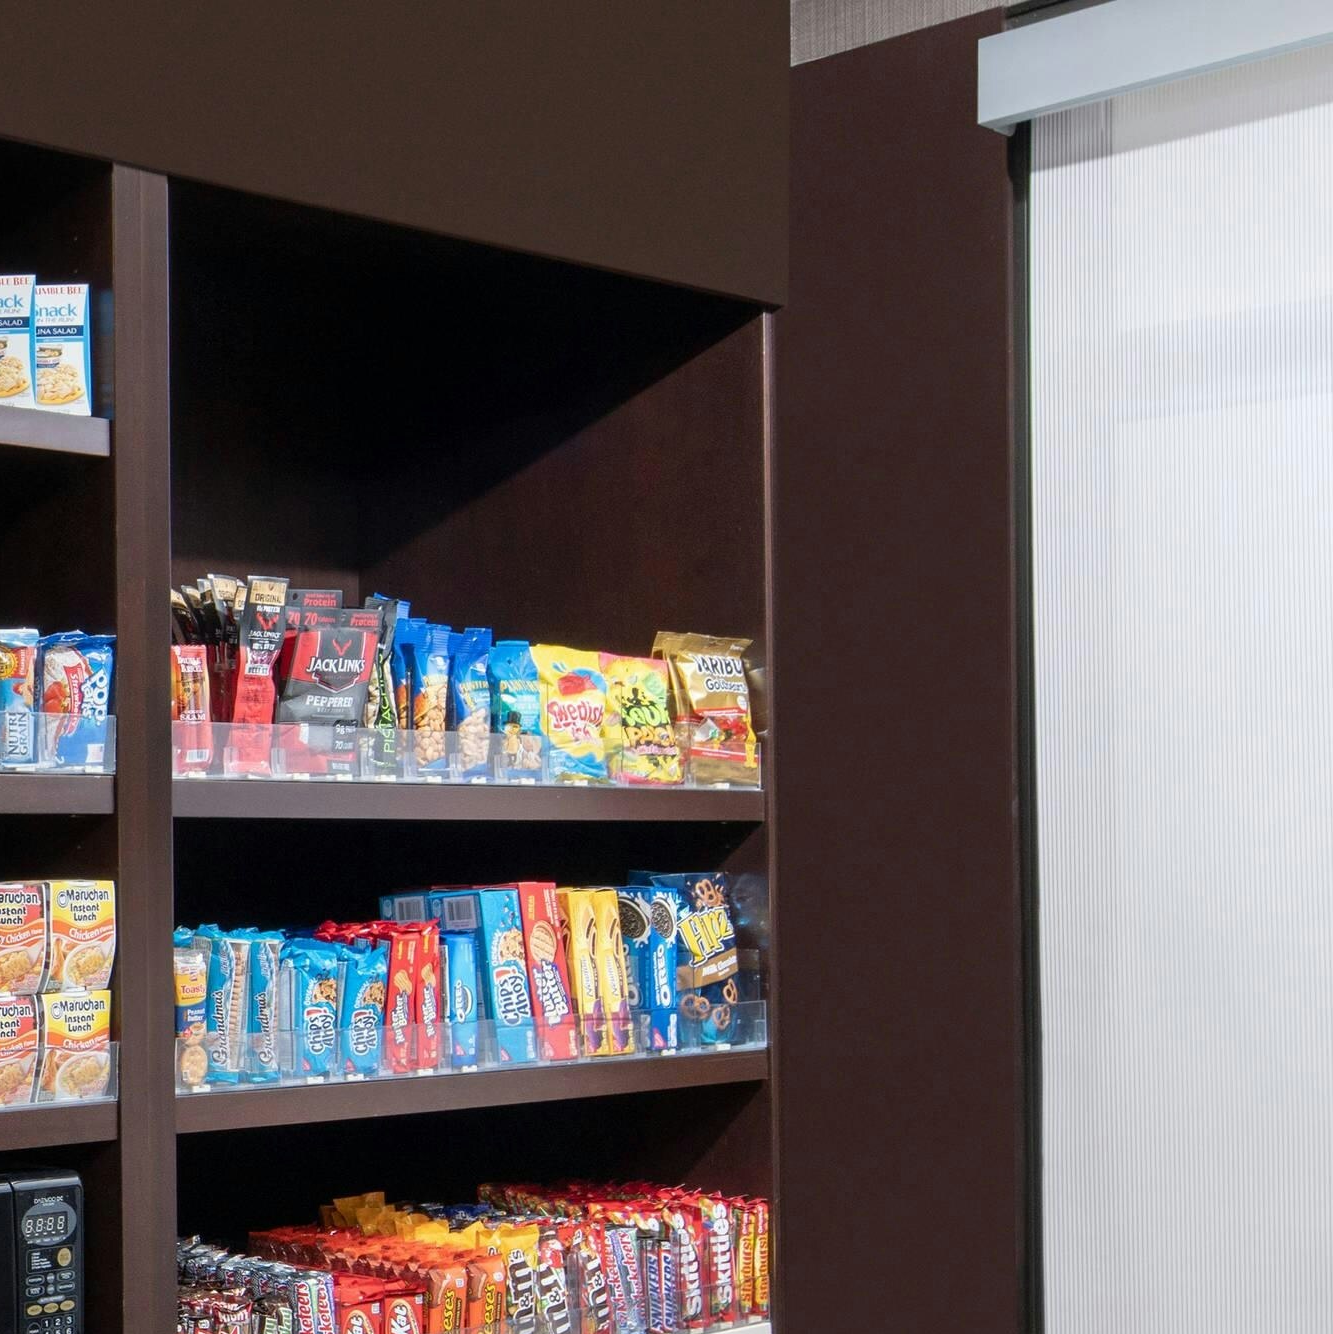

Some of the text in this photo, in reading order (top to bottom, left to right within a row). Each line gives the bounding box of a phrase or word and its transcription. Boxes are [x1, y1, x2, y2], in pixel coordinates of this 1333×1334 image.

[303, 598, 337, 607] Protein
[350, 617, 378, 626] Protein
[306, 657, 338, 673] JACK
[8, 711, 19, 756] NUTRI
[20, 712, 28, 756] GRAIN
[65, 889, 110, 901] Maruchan
[70, 903, 100, 913] Instant
[69, 926, 98, 938] Chicken
[73, 911, 97, 921] Lunch
[657, 944, 670, 1008] OREO
[212, 991, 228, 1065] Grandma's
[254, 992, 273, 1065] Grandma's
[310, 1016, 324, 1055] Chips
[351, 1017, 369, 1055] Chips
[662, 1254, 675, 1329] SNICKERS
